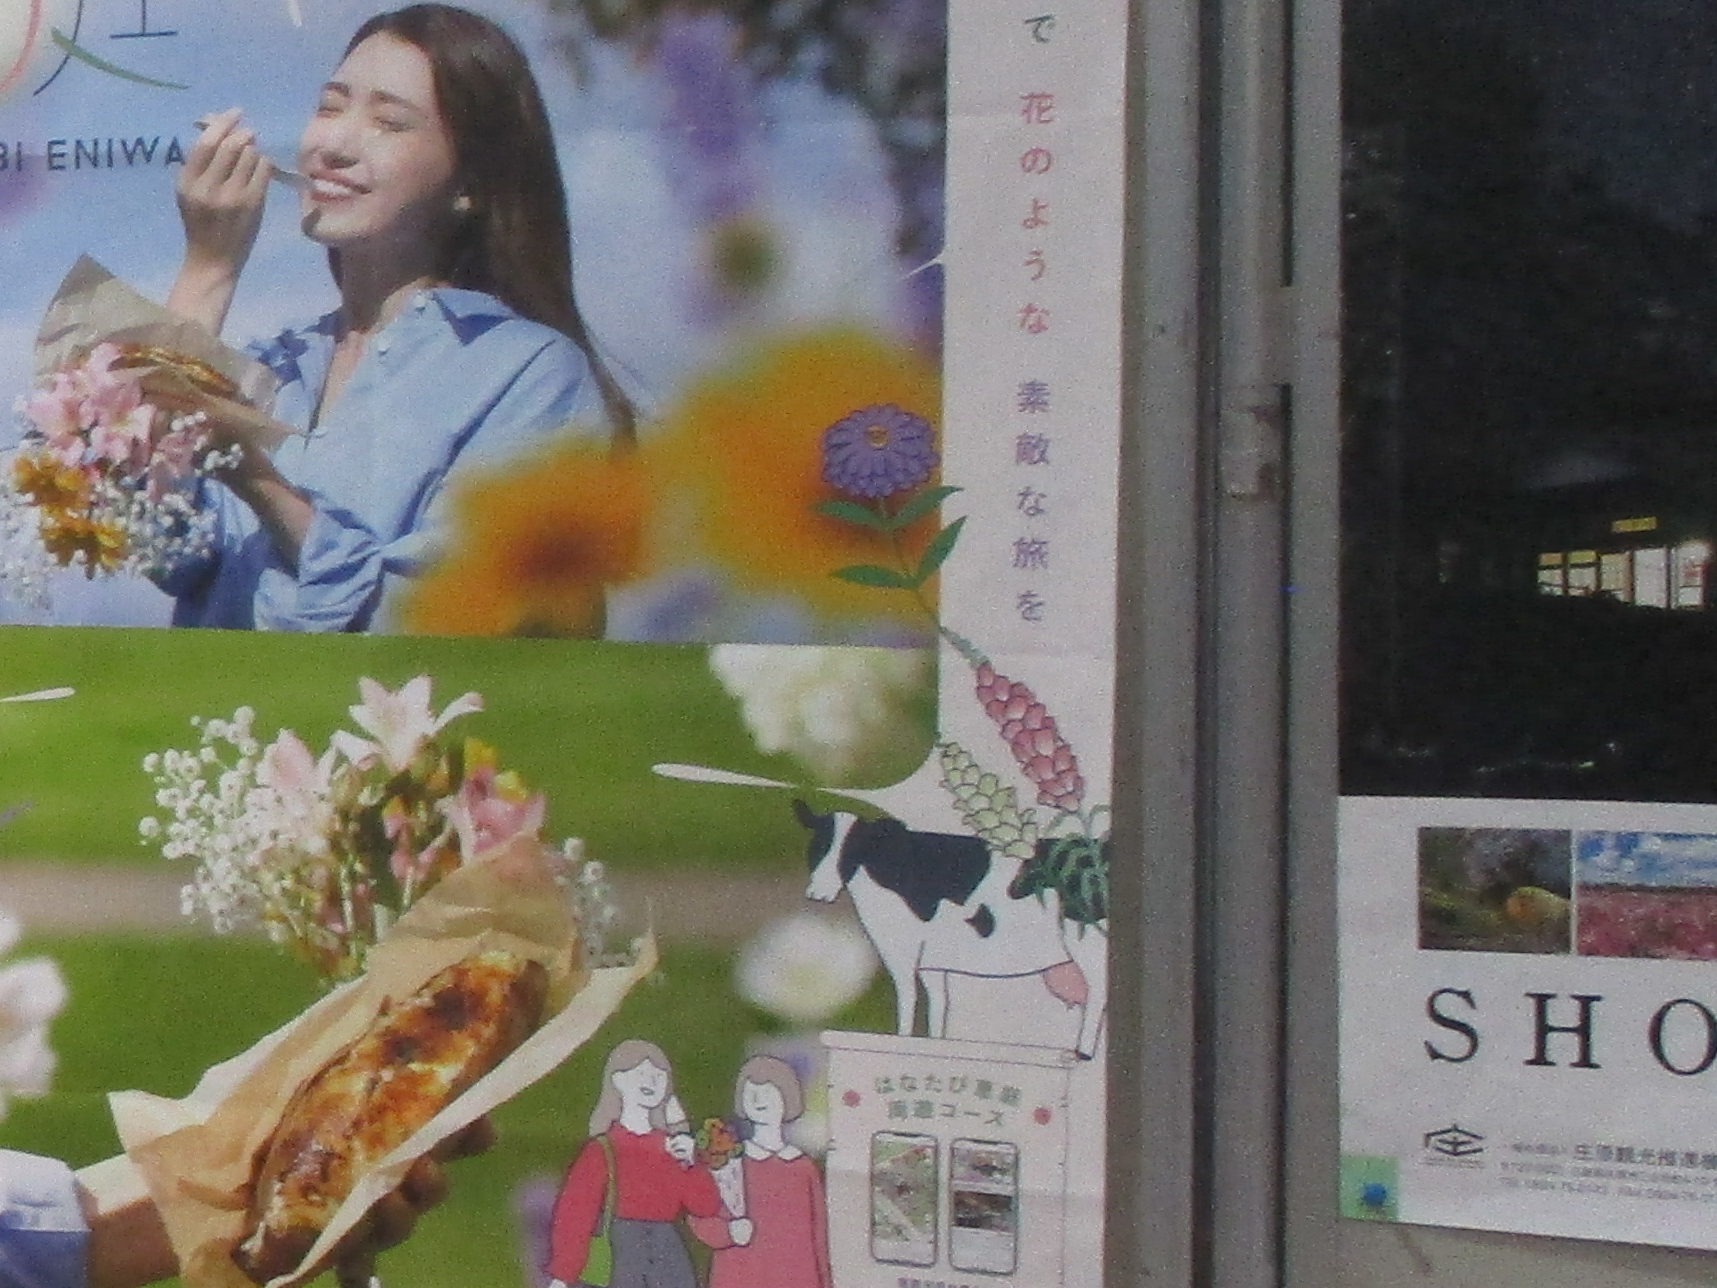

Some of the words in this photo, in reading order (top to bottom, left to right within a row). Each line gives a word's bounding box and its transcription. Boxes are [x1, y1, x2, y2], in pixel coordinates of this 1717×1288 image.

[47, 134, 187, 172] ENIWA
[1016, 91, 1055, 336] 花のような
[1010, 379, 1052, 625] 素敵な旅を
[1423, 987, 1717, 1076] SHO
